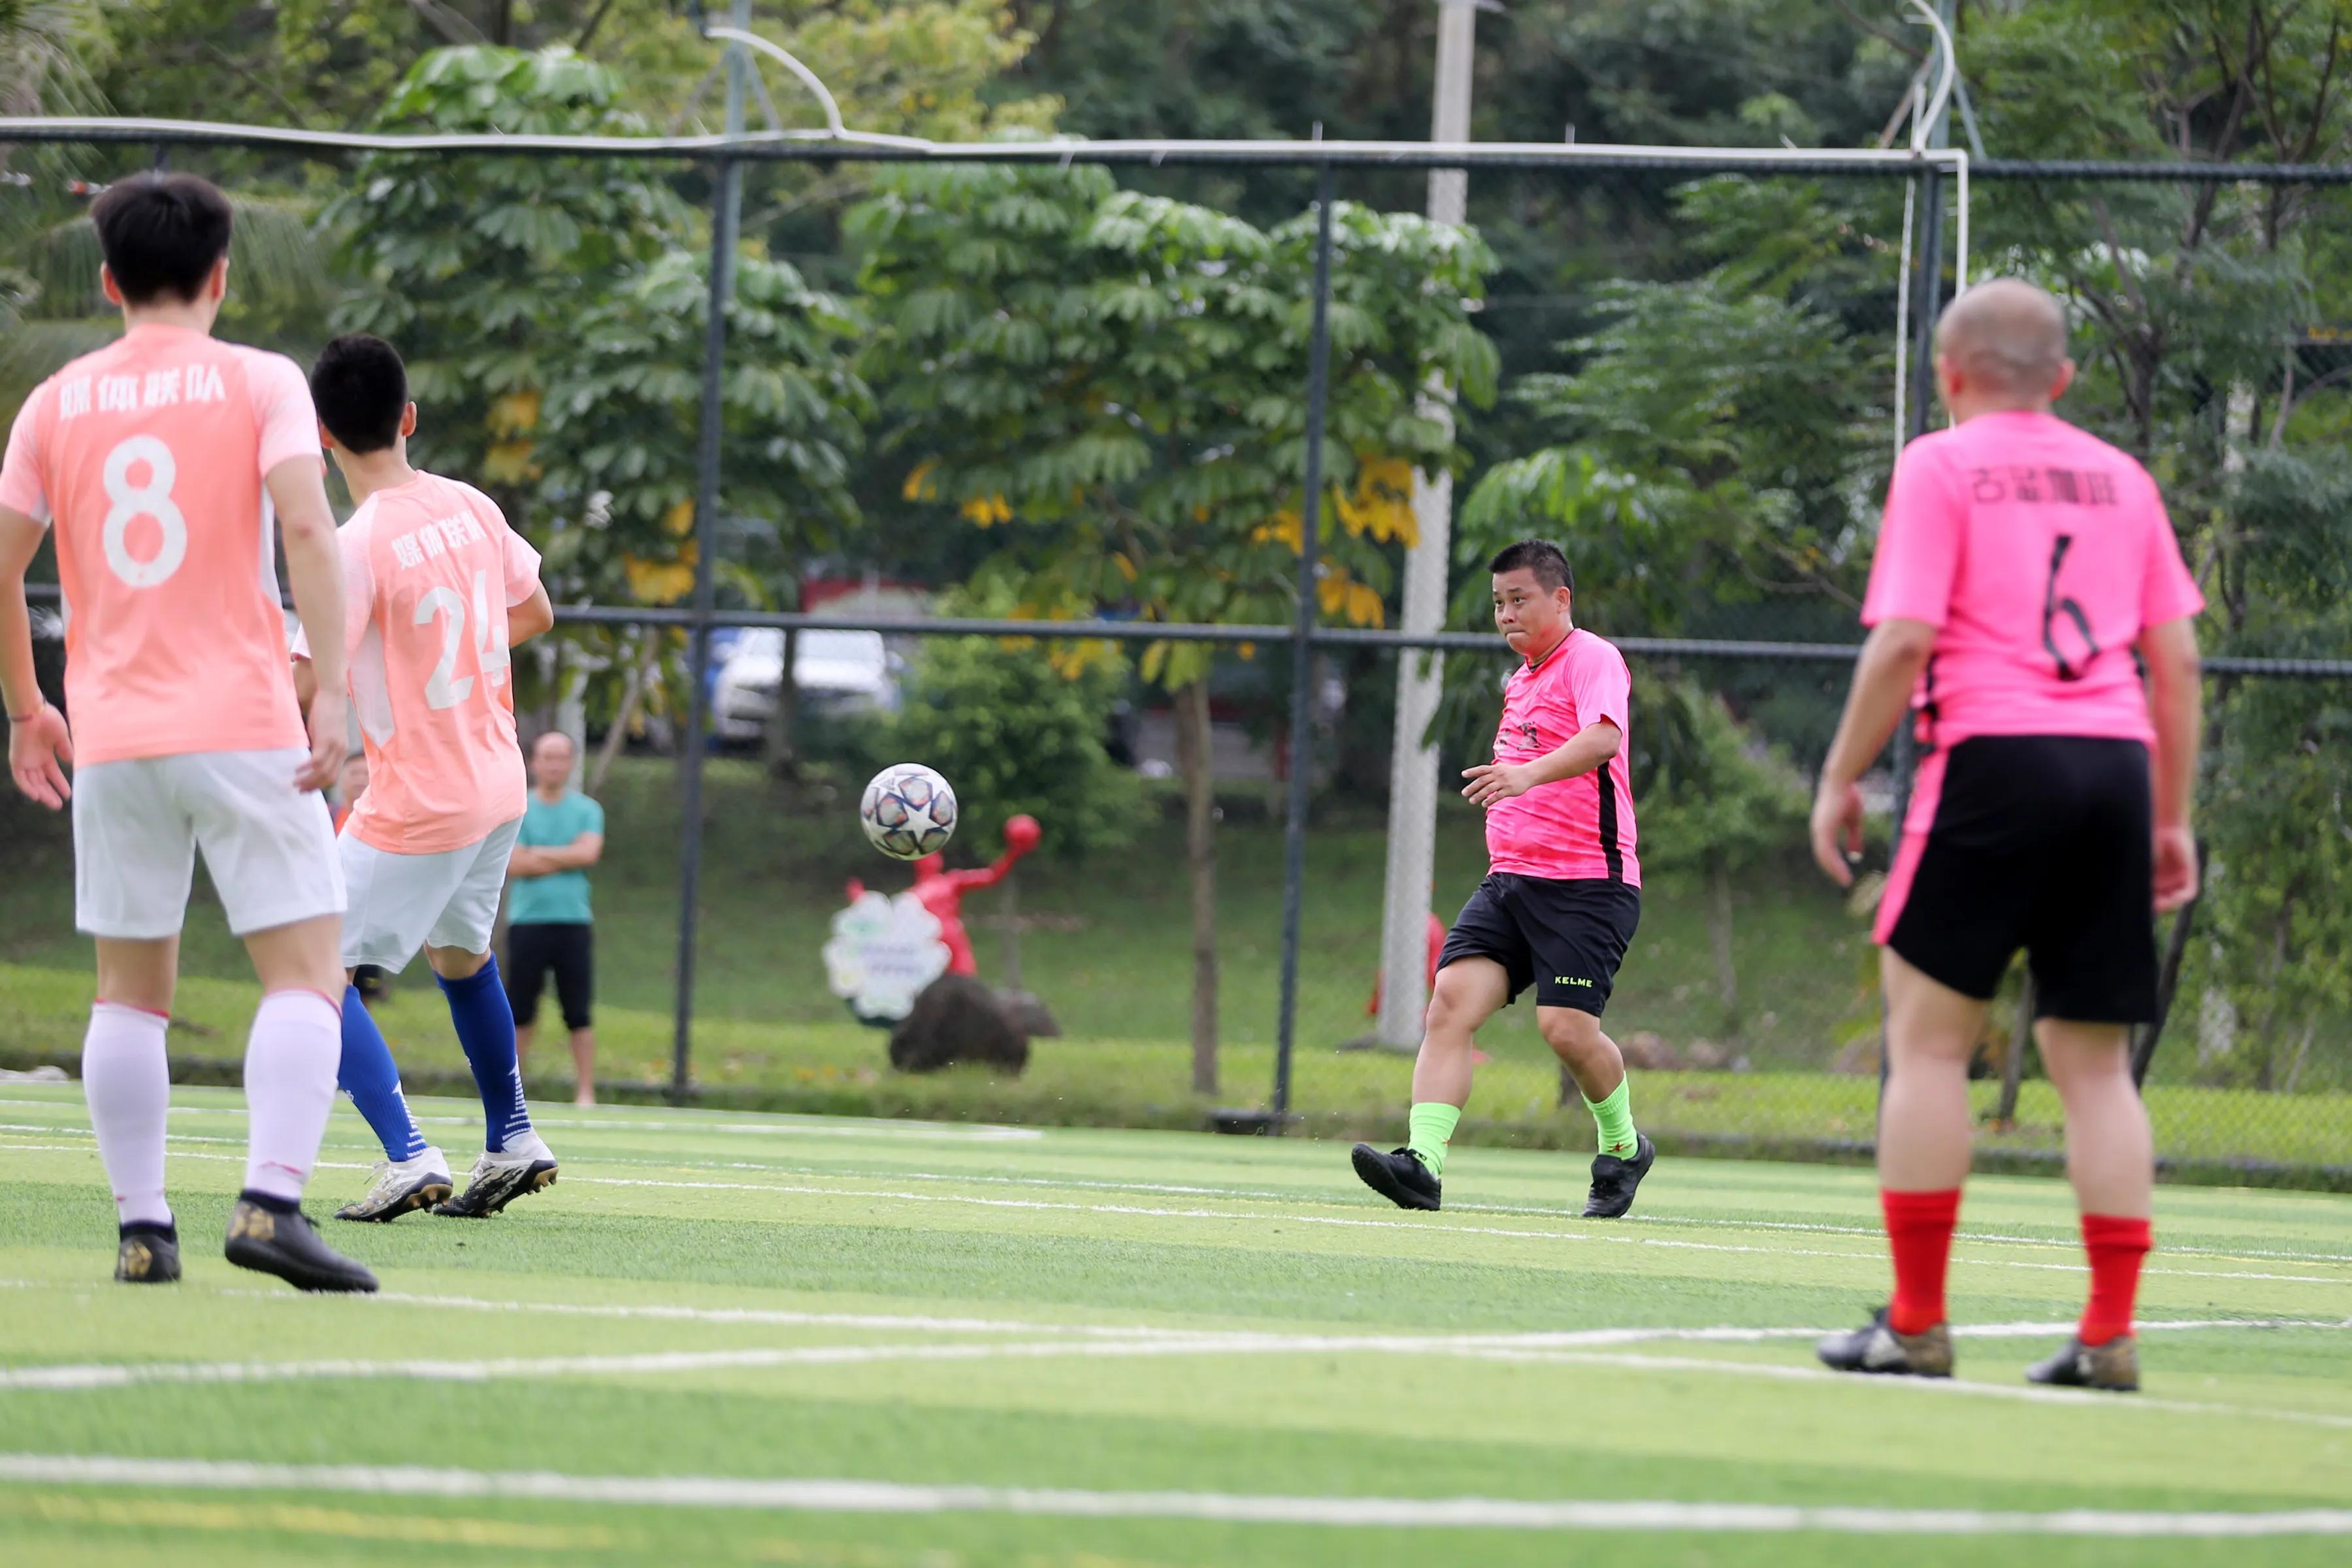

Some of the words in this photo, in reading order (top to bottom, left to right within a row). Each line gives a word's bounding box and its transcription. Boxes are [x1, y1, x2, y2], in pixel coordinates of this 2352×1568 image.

[103, 434, 188, 588] 8
[414, 568, 512, 710] 24
[2042, 534, 2100, 682] 6
[1554, 976, 1593, 988] KELME
